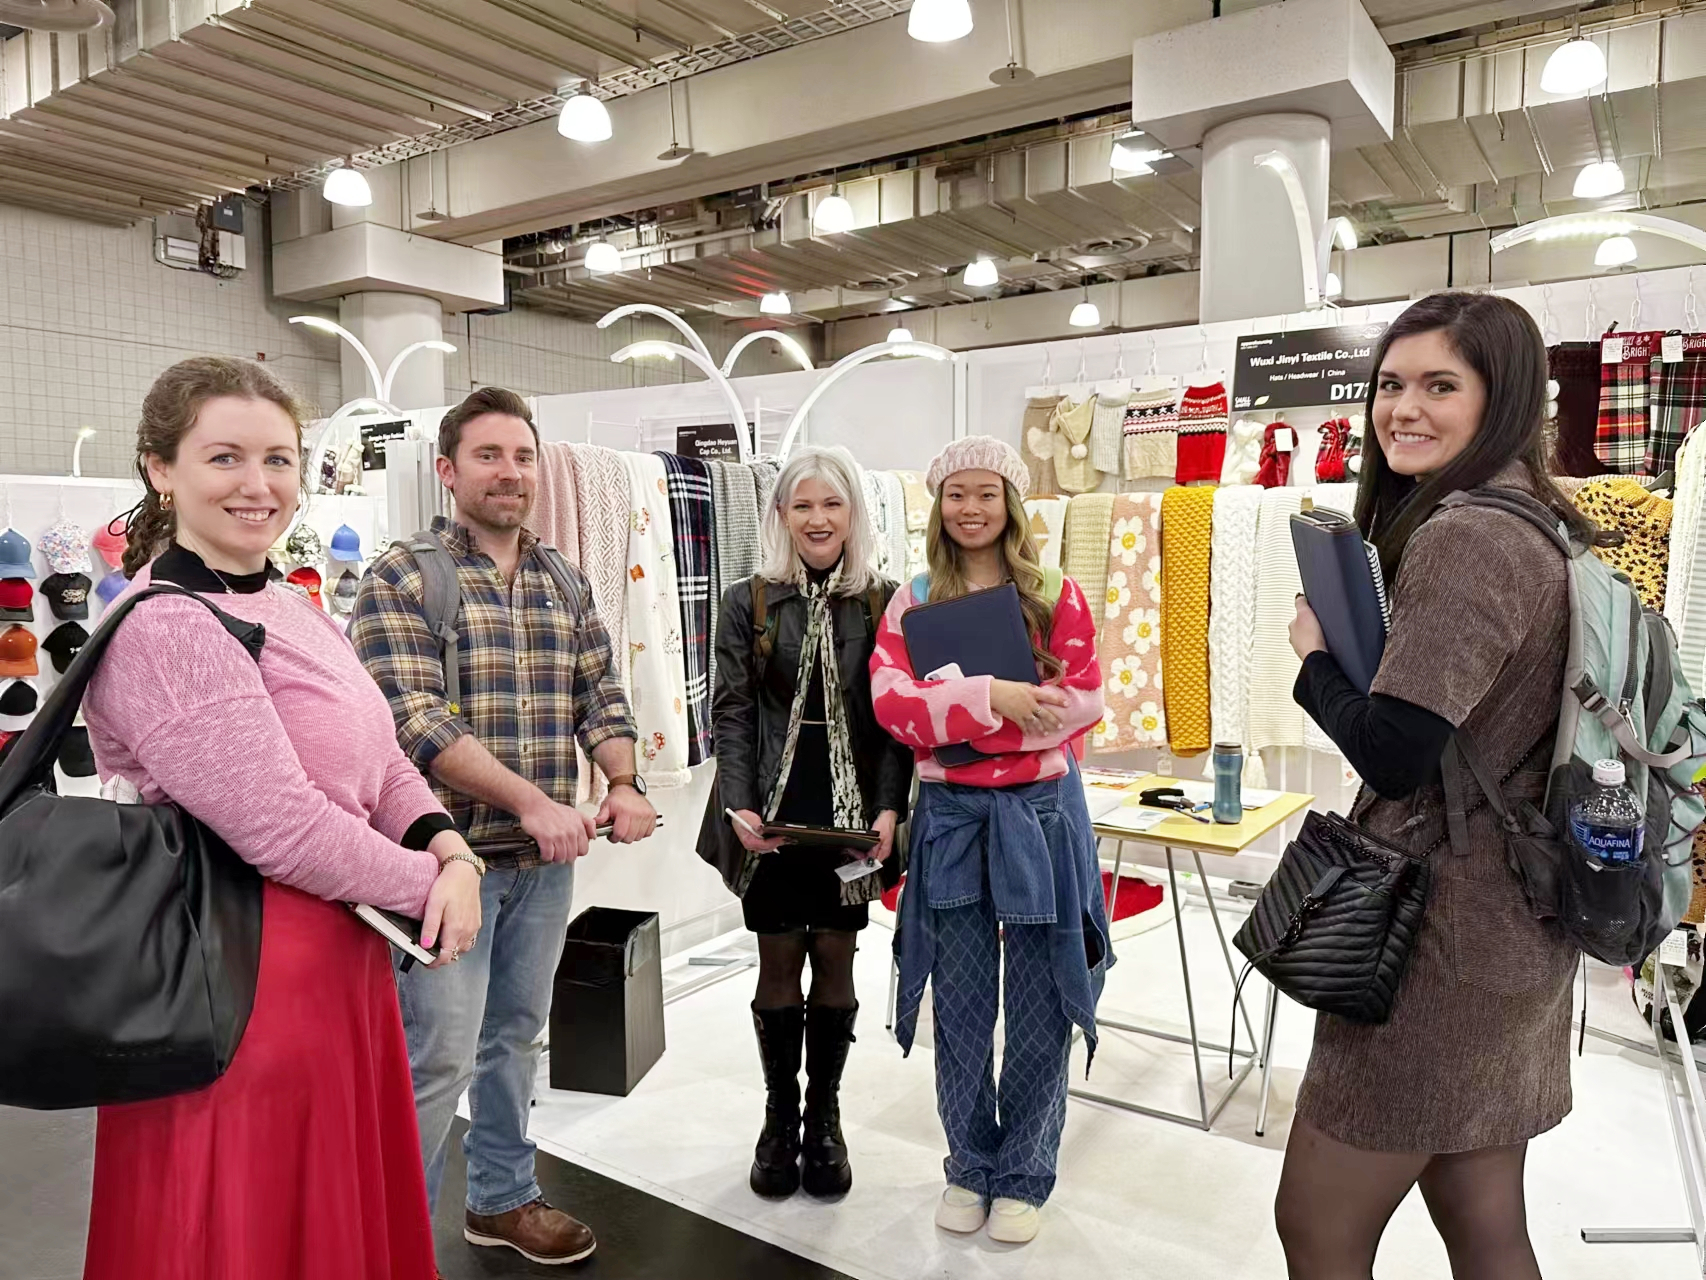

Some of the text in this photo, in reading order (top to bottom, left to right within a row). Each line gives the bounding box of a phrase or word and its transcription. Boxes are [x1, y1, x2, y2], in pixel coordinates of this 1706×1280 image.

[1250, 347, 1370, 367] Wuxi Jinyi Textile Co.,Ltd
[1288, 371, 1319, 380] Headwear
[1327, 369, 1346, 377] China
[695, 439, 716, 447] Qingdao
[699, 448, 710, 456] Cap
[1588, 836, 1631, 848] AQUAFINA
